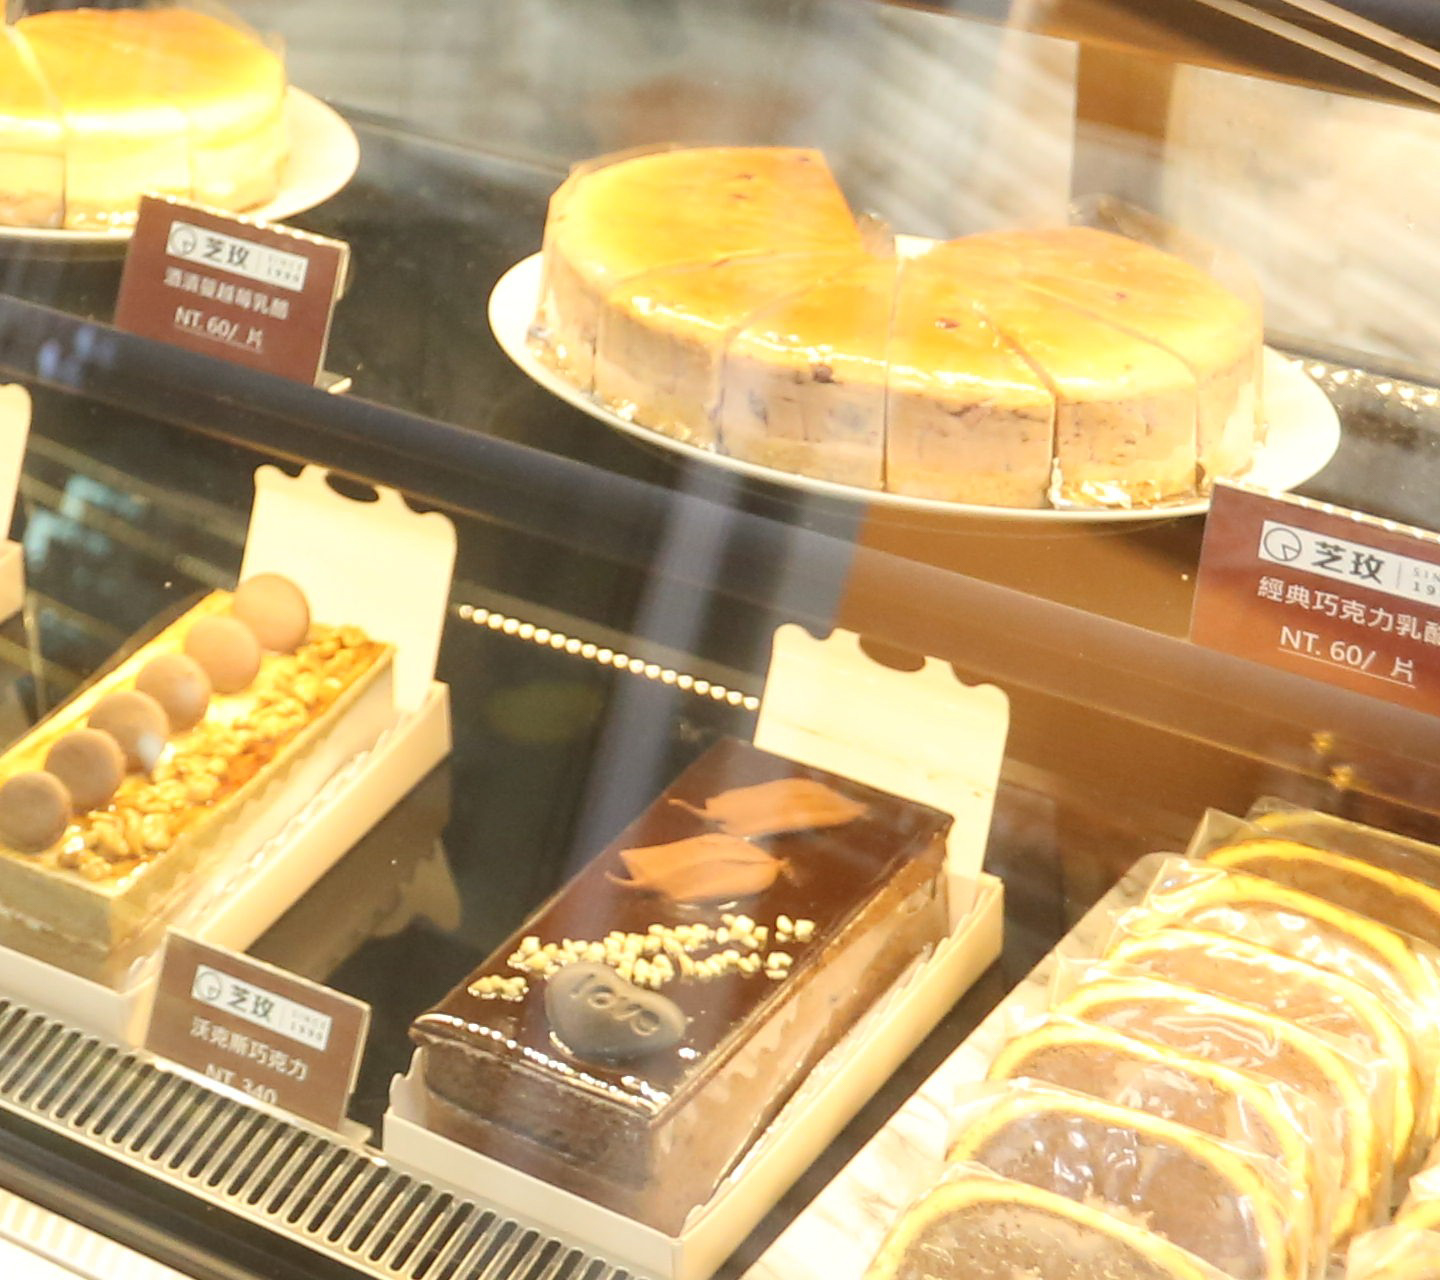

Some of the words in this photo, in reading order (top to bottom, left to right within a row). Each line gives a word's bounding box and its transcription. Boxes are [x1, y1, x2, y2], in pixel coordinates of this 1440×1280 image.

[1311, 540, 1385, 584] 芝玫
[1280, 626, 1321, 656] NT.
[1330, 641, 1376, 670] 60/
[1391, 657, 1414, 682] 片
[228, 983, 275, 1022] 芝玫
